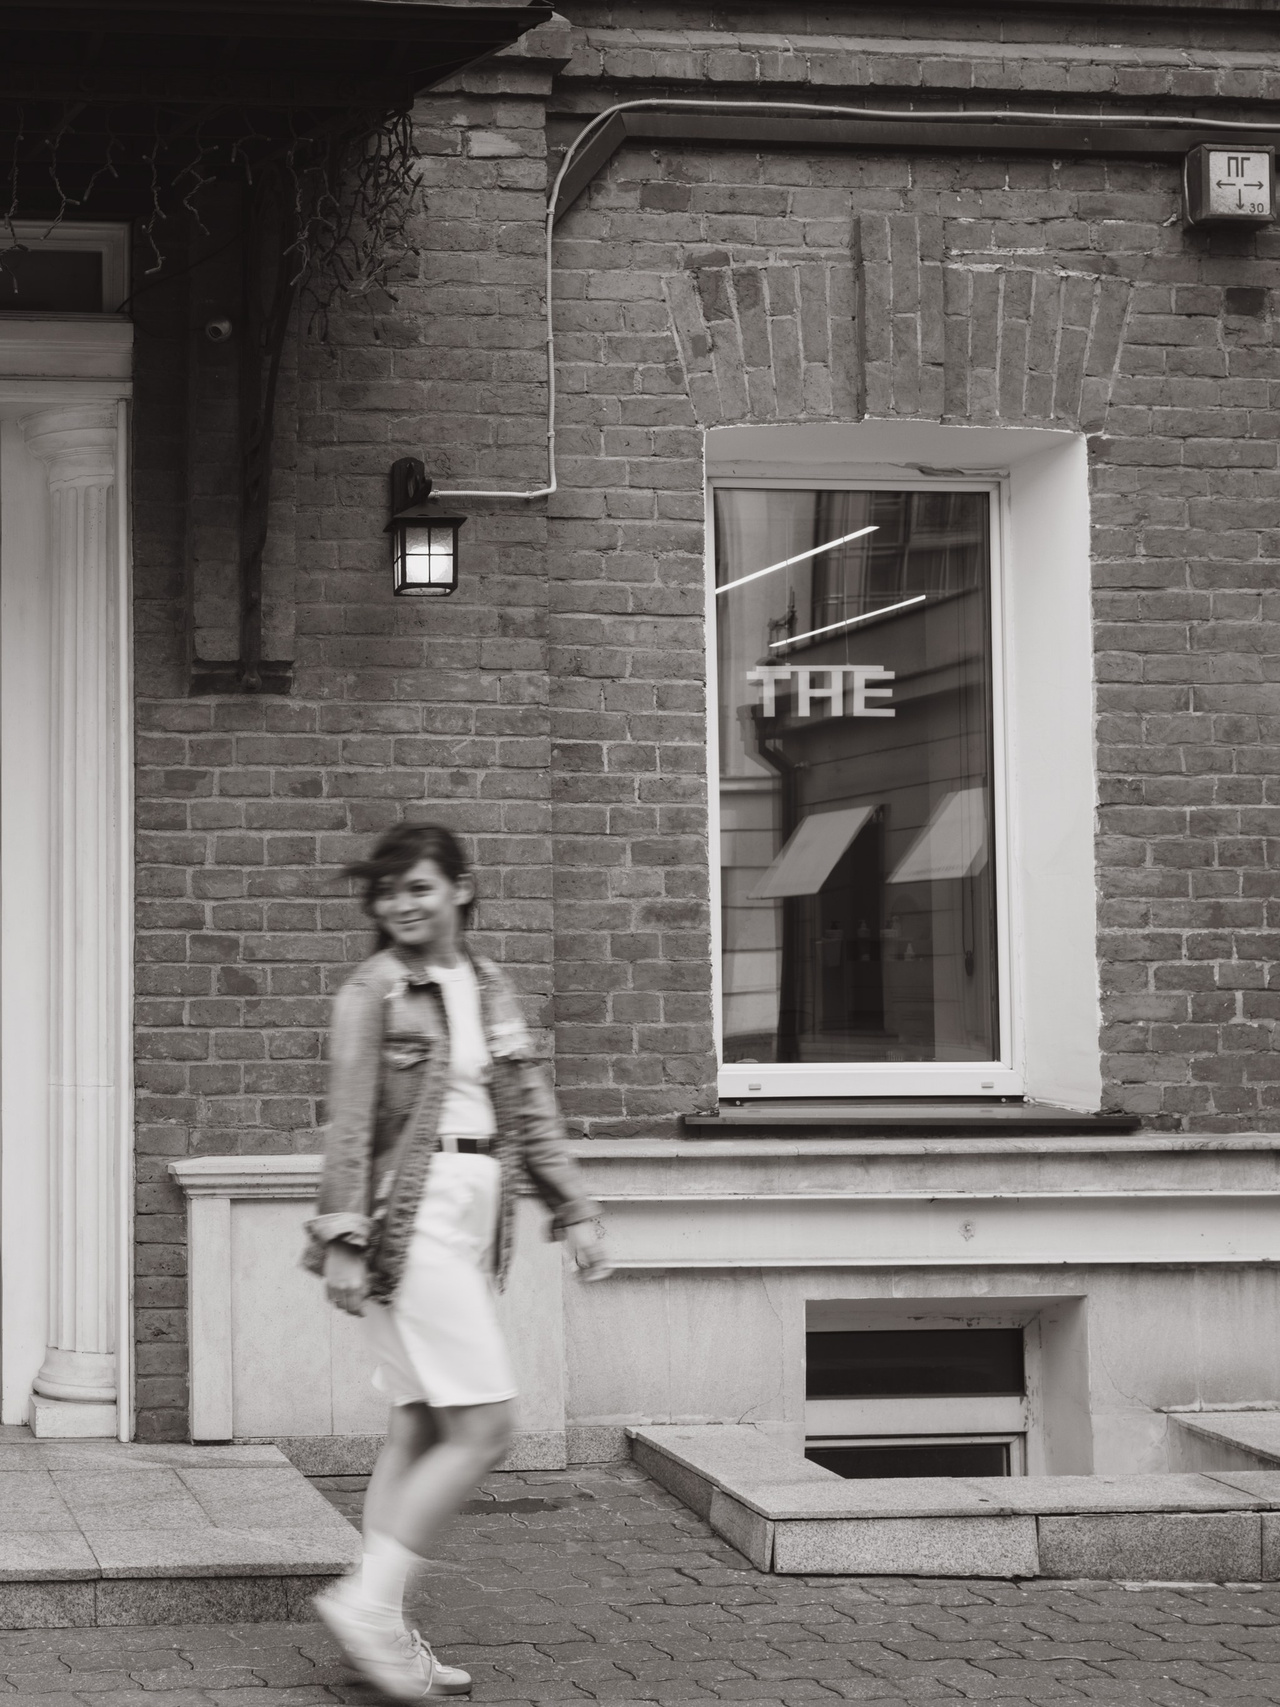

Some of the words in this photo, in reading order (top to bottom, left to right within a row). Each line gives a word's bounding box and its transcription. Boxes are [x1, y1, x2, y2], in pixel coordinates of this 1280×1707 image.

[1227, 156, 1251, 178] ПГ
[1249, 202, 1265, 214] 30
[746, 671, 896, 717] THE
